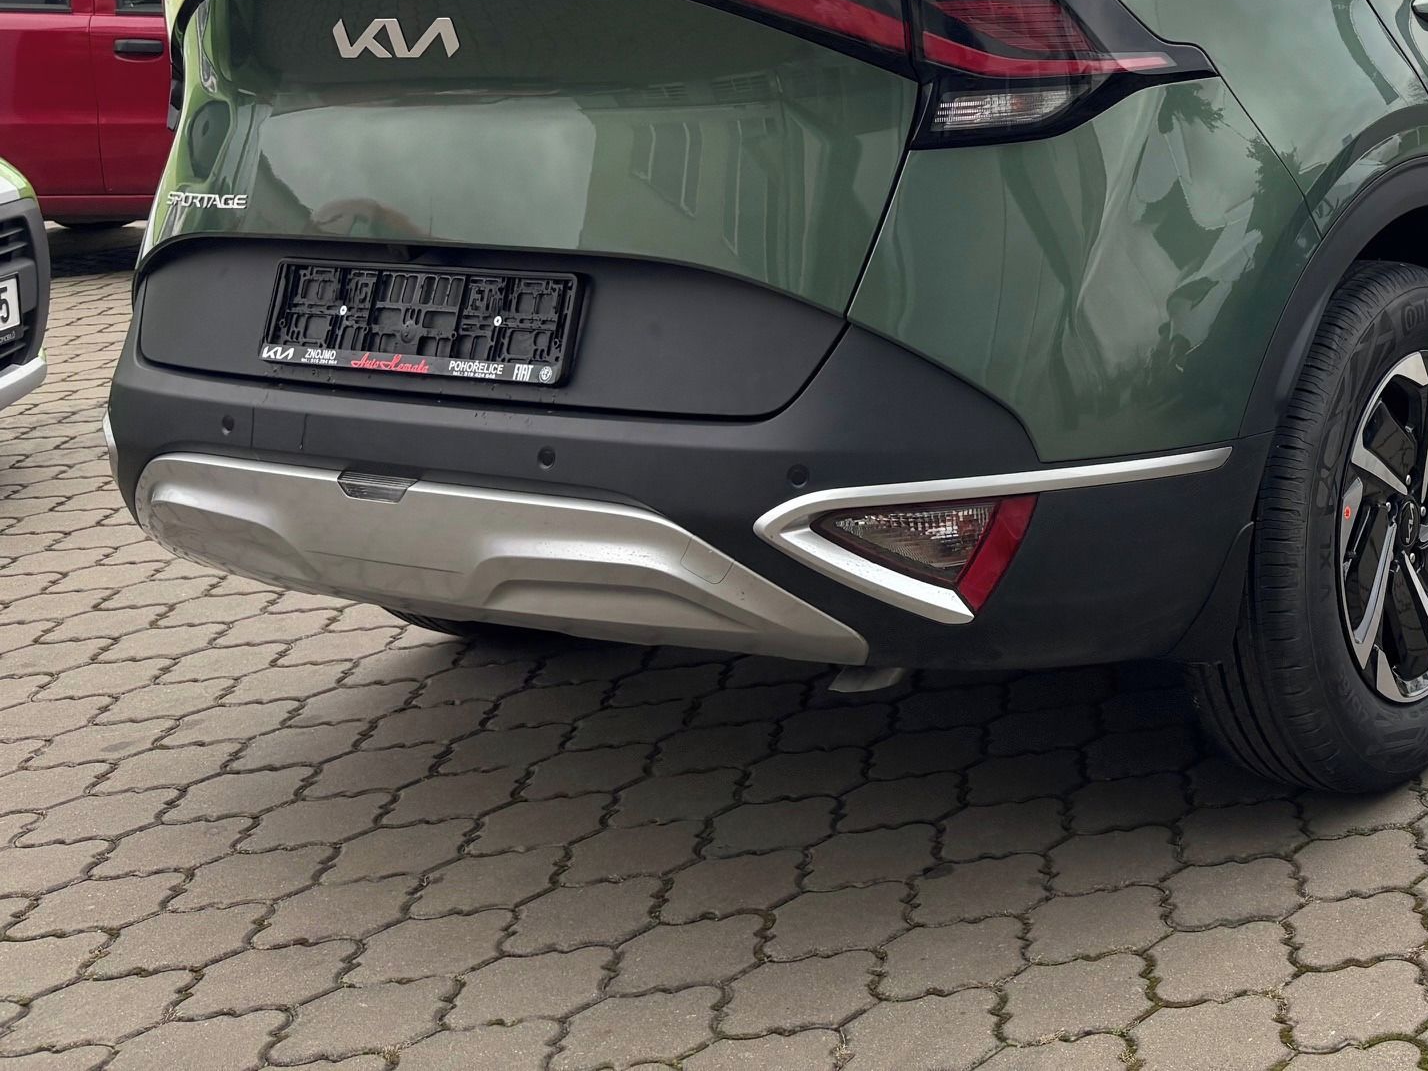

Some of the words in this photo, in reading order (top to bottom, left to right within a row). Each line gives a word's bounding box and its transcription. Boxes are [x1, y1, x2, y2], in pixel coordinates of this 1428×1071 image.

[332, 17, 460, 59] KIA
[166, 190, 248, 209] SPORTAGE
[0, 285, 10, 324] 5
[262, 345, 295, 360] KIA
[304, 348, 337, 360] ZNOJMO
[448, 360, 504, 375] POHOŘELICE
[512, 363, 534, 382] FIAT
